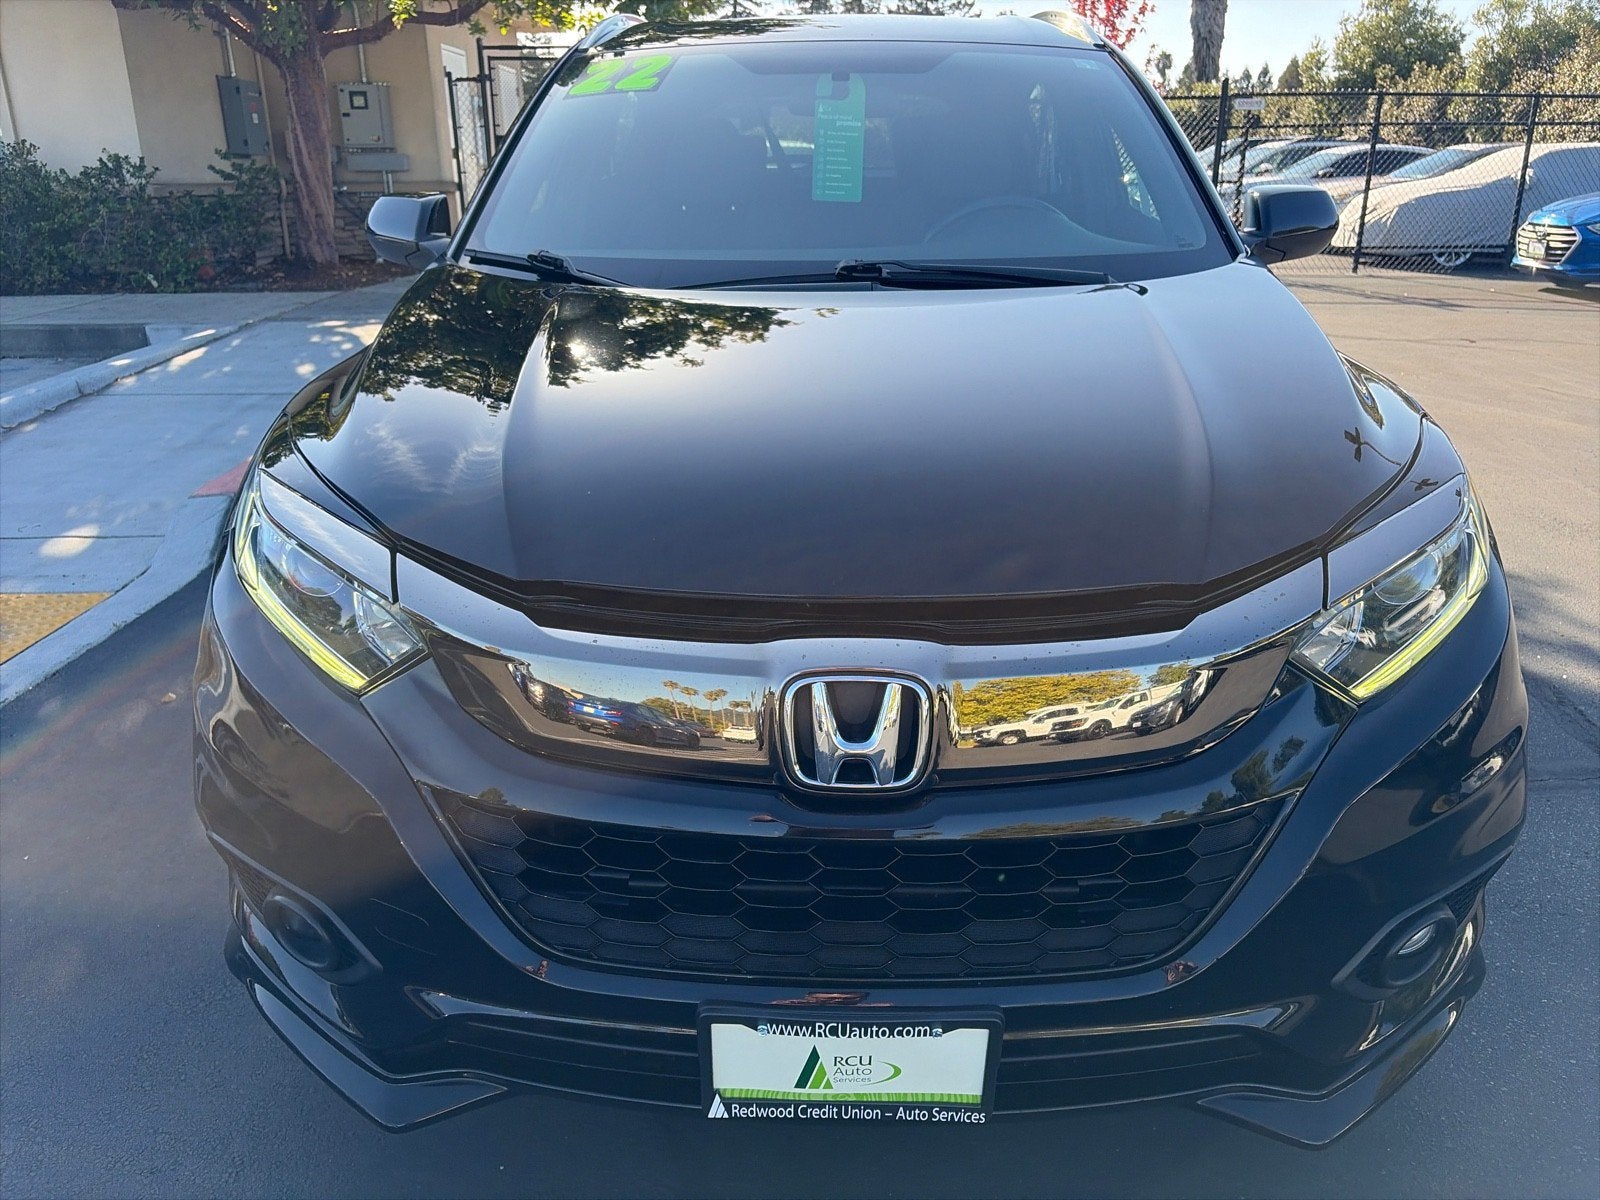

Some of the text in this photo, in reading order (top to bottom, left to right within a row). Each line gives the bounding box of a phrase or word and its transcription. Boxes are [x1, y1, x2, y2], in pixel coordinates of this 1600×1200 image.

[568, 54, 673, 96] 22
[767, 1022, 930, 1040] www.RCUauto.com
[833, 1055, 873, 1067] RCU
[833, 1067, 873, 1076] Auto
[833, 1076, 872, 1084] Services
[731, 1103, 795, 1119] Redwood
[797, 1104, 839, 1120] Credit
[841, 1105, 882, 1121] Union
[895, 1106, 929, 1122] Auto
[931, 1107, 986, 1124] Services
